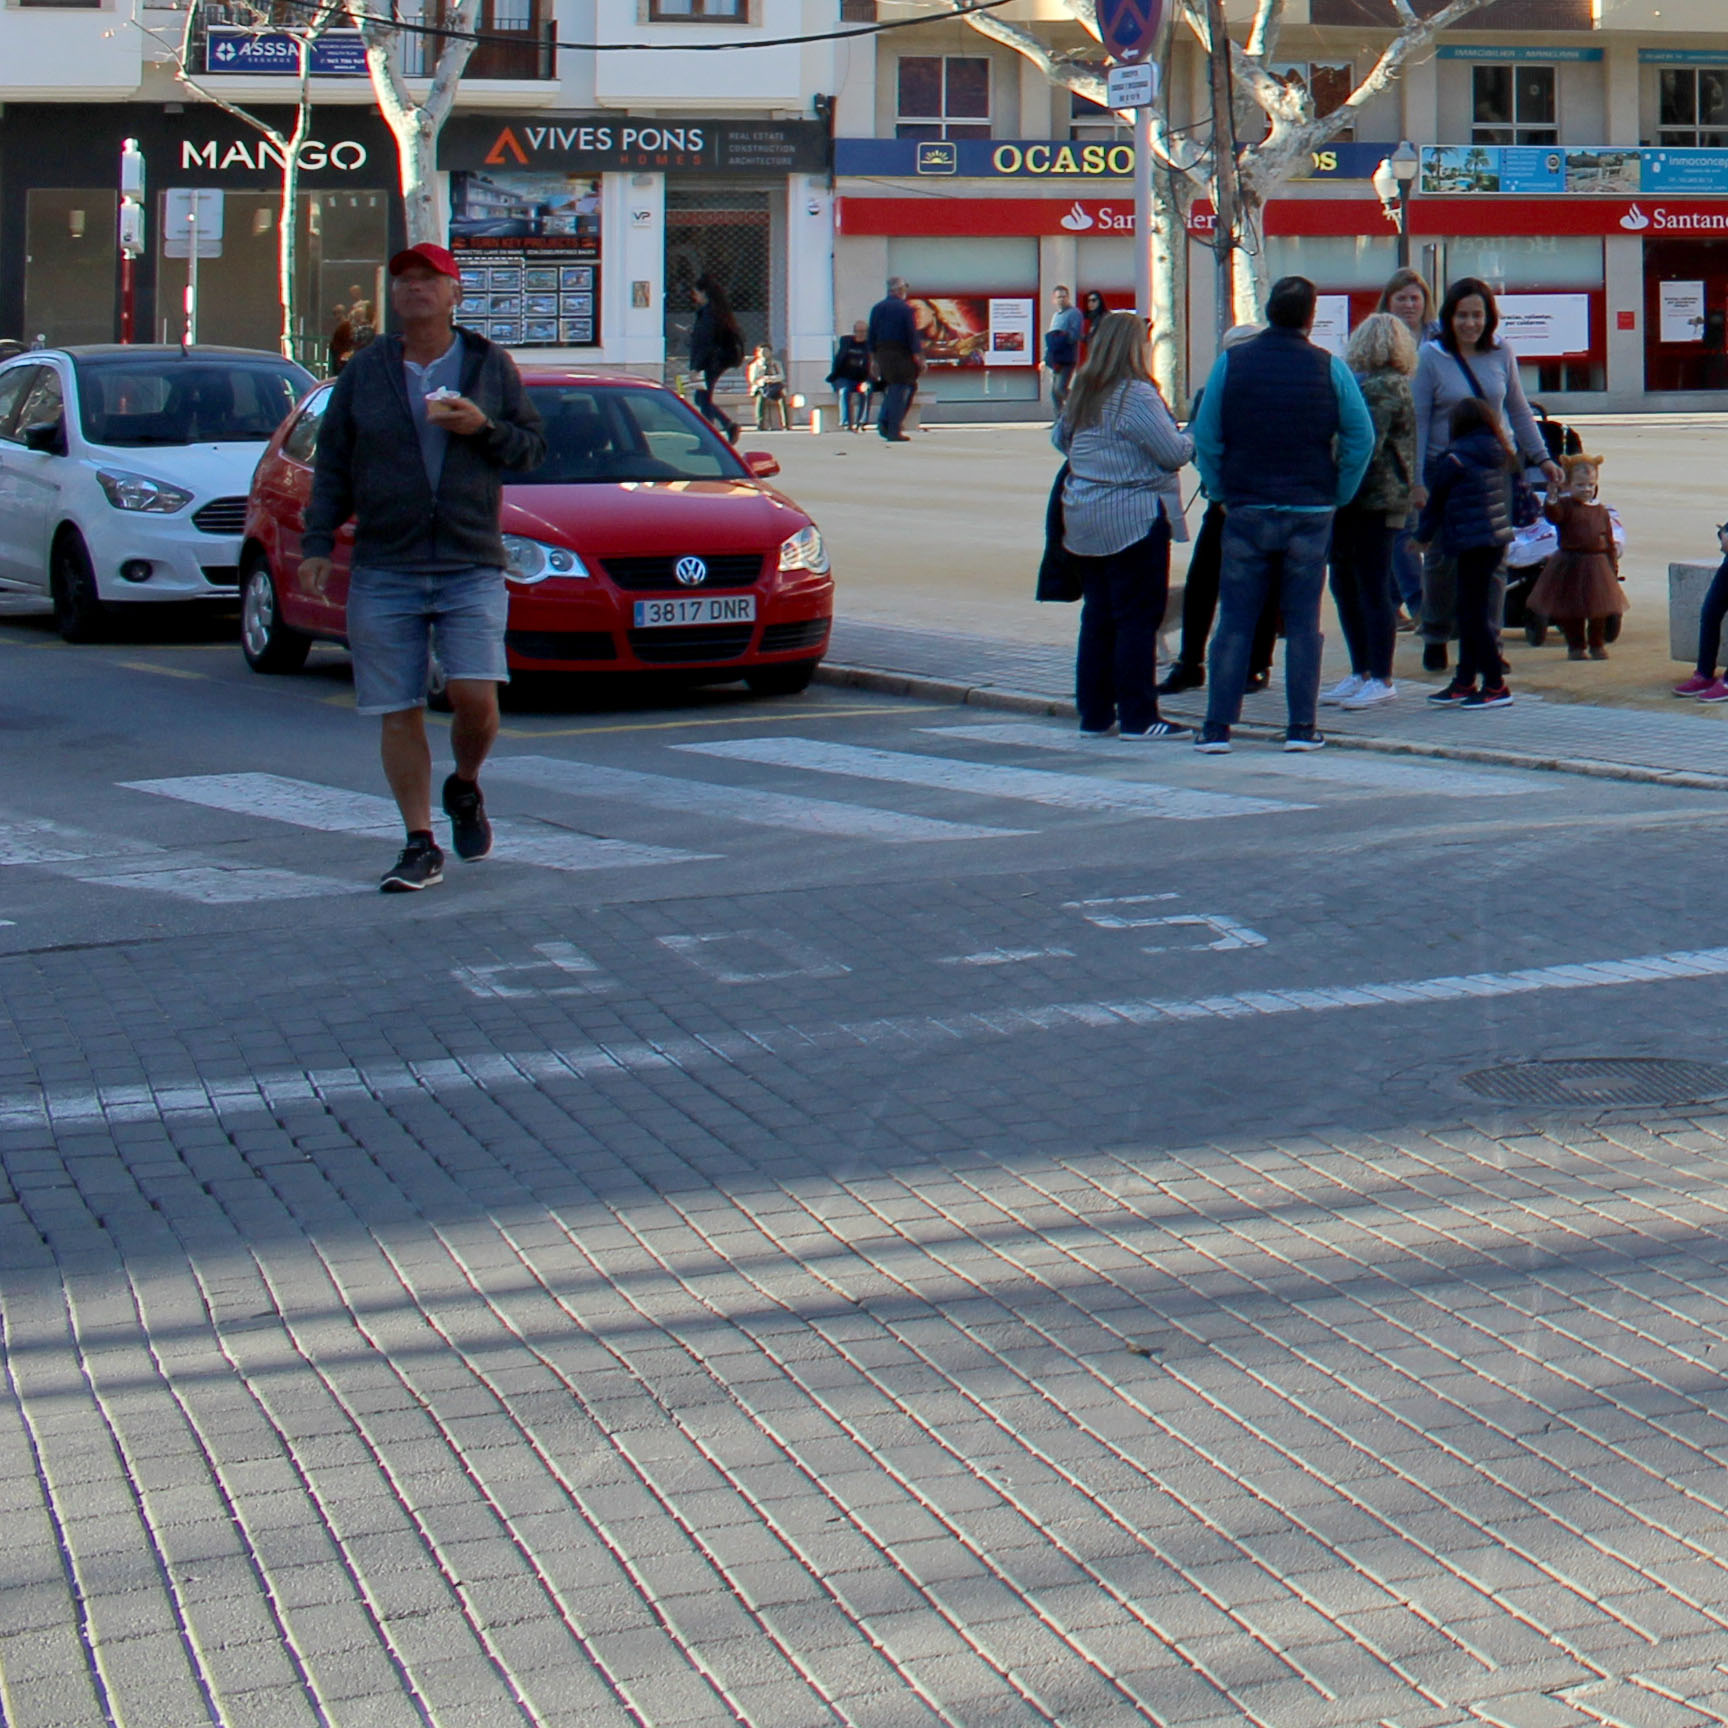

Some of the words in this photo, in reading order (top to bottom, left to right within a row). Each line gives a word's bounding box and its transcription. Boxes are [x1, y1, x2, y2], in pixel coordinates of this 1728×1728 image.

[238, 42, 299, 57] ASSSA
[525, 127, 612, 151] VIVES
[621, 128, 704, 152] PONS
[181, 140, 367, 171] MANGO
[620, 154, 702, 166] HOMES
[992, 144, 1136, 174] OCASO
[649, 600, 703, 622] 3817
[709, 598, 750, 621] DNR
